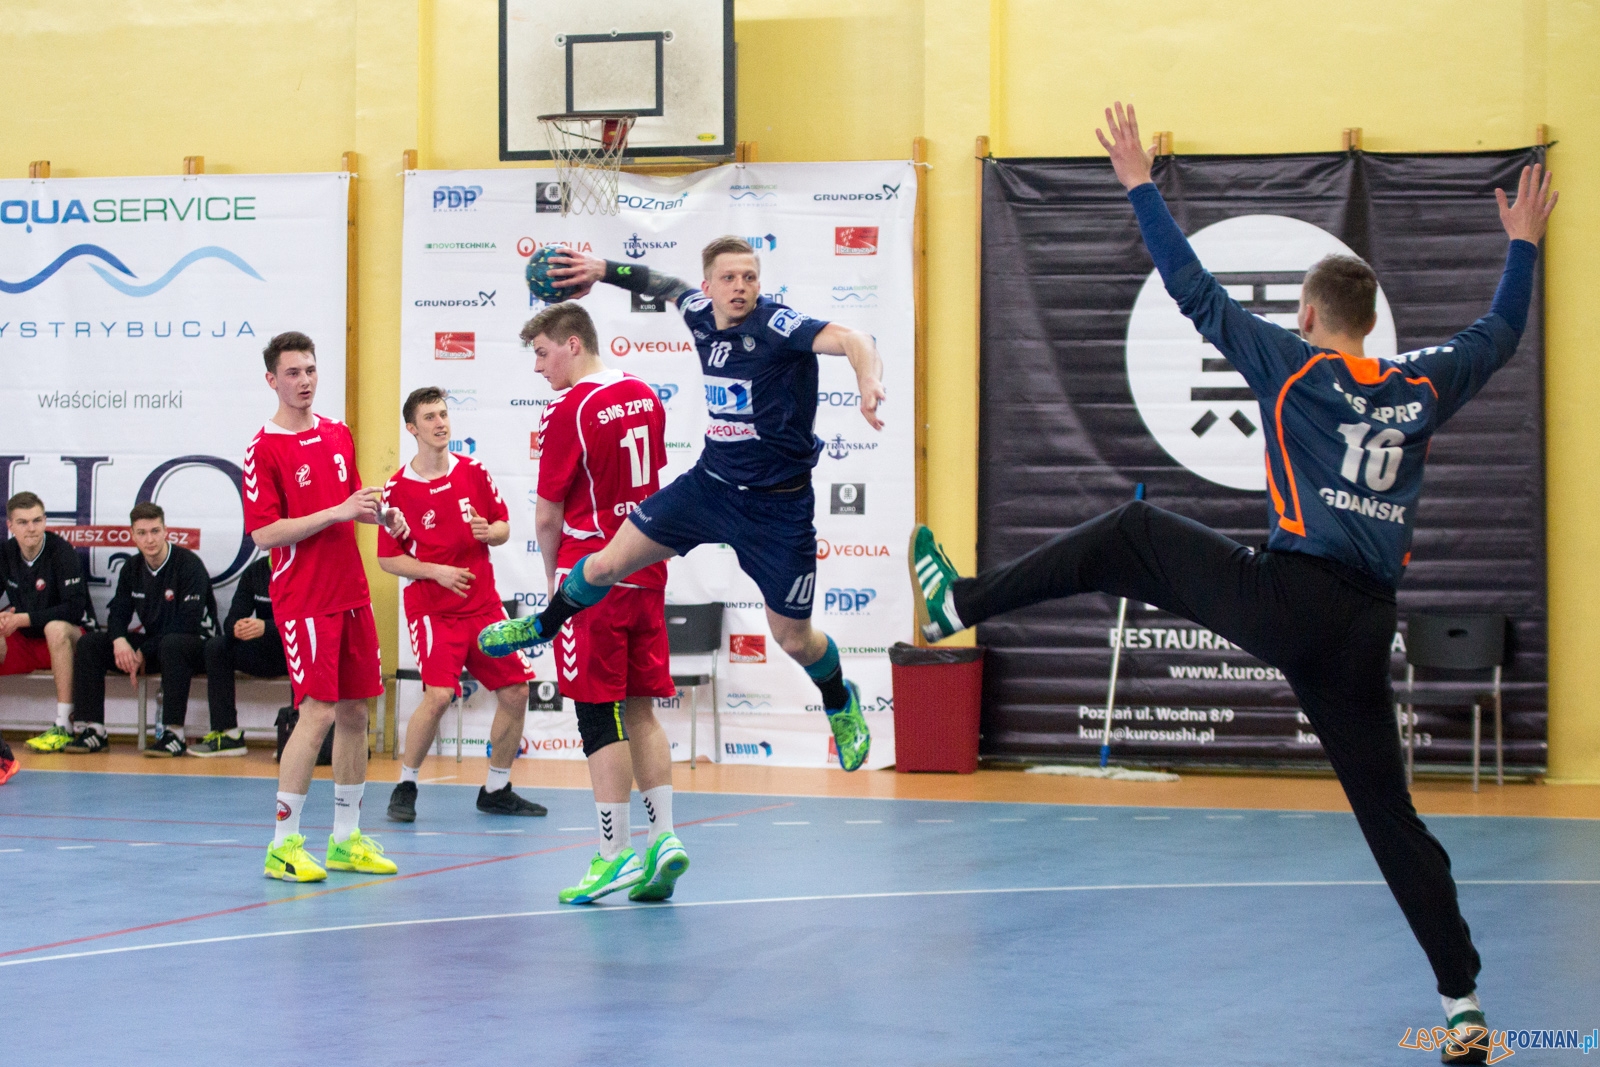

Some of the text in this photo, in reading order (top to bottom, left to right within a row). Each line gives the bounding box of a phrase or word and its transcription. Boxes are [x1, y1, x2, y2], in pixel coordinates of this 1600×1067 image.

[433, 186, 481, 209] PDP
[813, 193, 883, 201] GRUNDFOS
[622, 241, 678, 249] TRANSKAP
[414, 299, 479, 307] GRUNDFOS
[635, 341, 693, 353] VEOLIA
[708, 341, 733, 369] 10
[38, 390, 182, 409] właściciel marki
[597, 397, 655, 425] SMS ZPRP
[299, 435, 323, 447] hummel
[826, 442, 878, 450] TRANSKAP
[620, 424, 650, 489] 17
[1337, 421, 1406, 492] 16
[333, 453, 348, 483] 3
[429, 481, 452, 495] hummel
[458, 497, 473, 523] 5
[1318, 486, 1407, 525] GDAŃSK
[55, 528, 131, 543] WIESZ CO
[834, 544, 891, 557] VEOLIA
[785, 571, 814, 605] 10
[825, 588, 877, 612] PDP
[1136, 706, 1154, 721] ul.
[1156, 707, 1207, 722] Wodna
[1210, 708, 1235, 723] 8/9
[531, 737, 584, 751] VEOLIA
[725, 742, 759, 755] ELBUD
